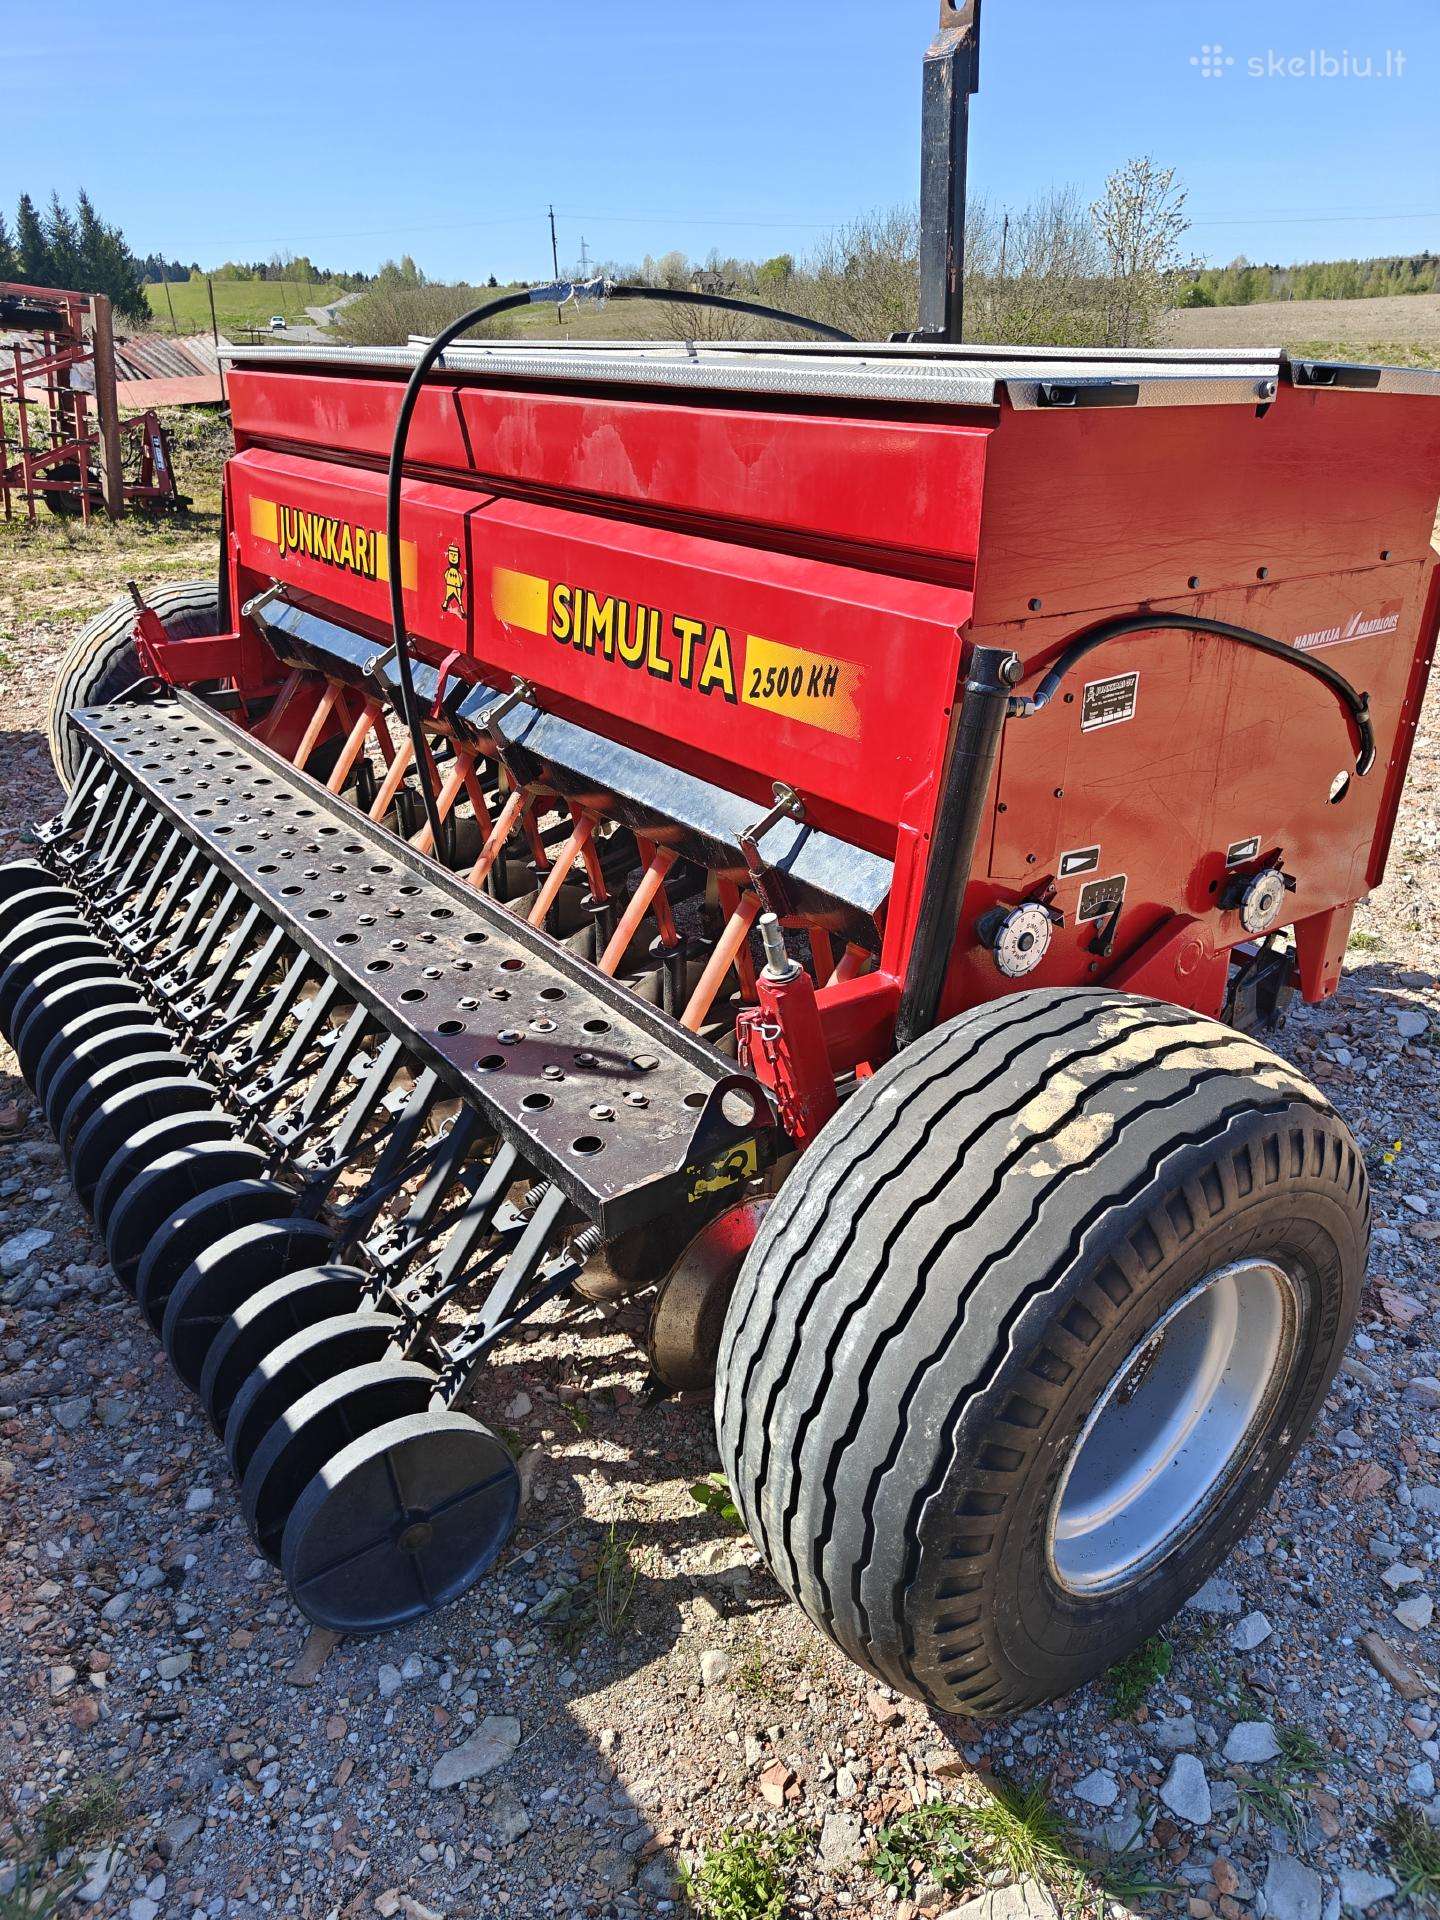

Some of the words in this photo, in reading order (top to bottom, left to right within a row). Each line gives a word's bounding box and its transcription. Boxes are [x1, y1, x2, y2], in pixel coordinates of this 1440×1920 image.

[279, 503, 377, 582] JUNKKARI
[550, 582, 738, 705] SIMULTA
[1293, 626, 1341, 649] HANKKIJA
[748, 665, 804, 698] 2500
[806, 664, 840, 698] KH
